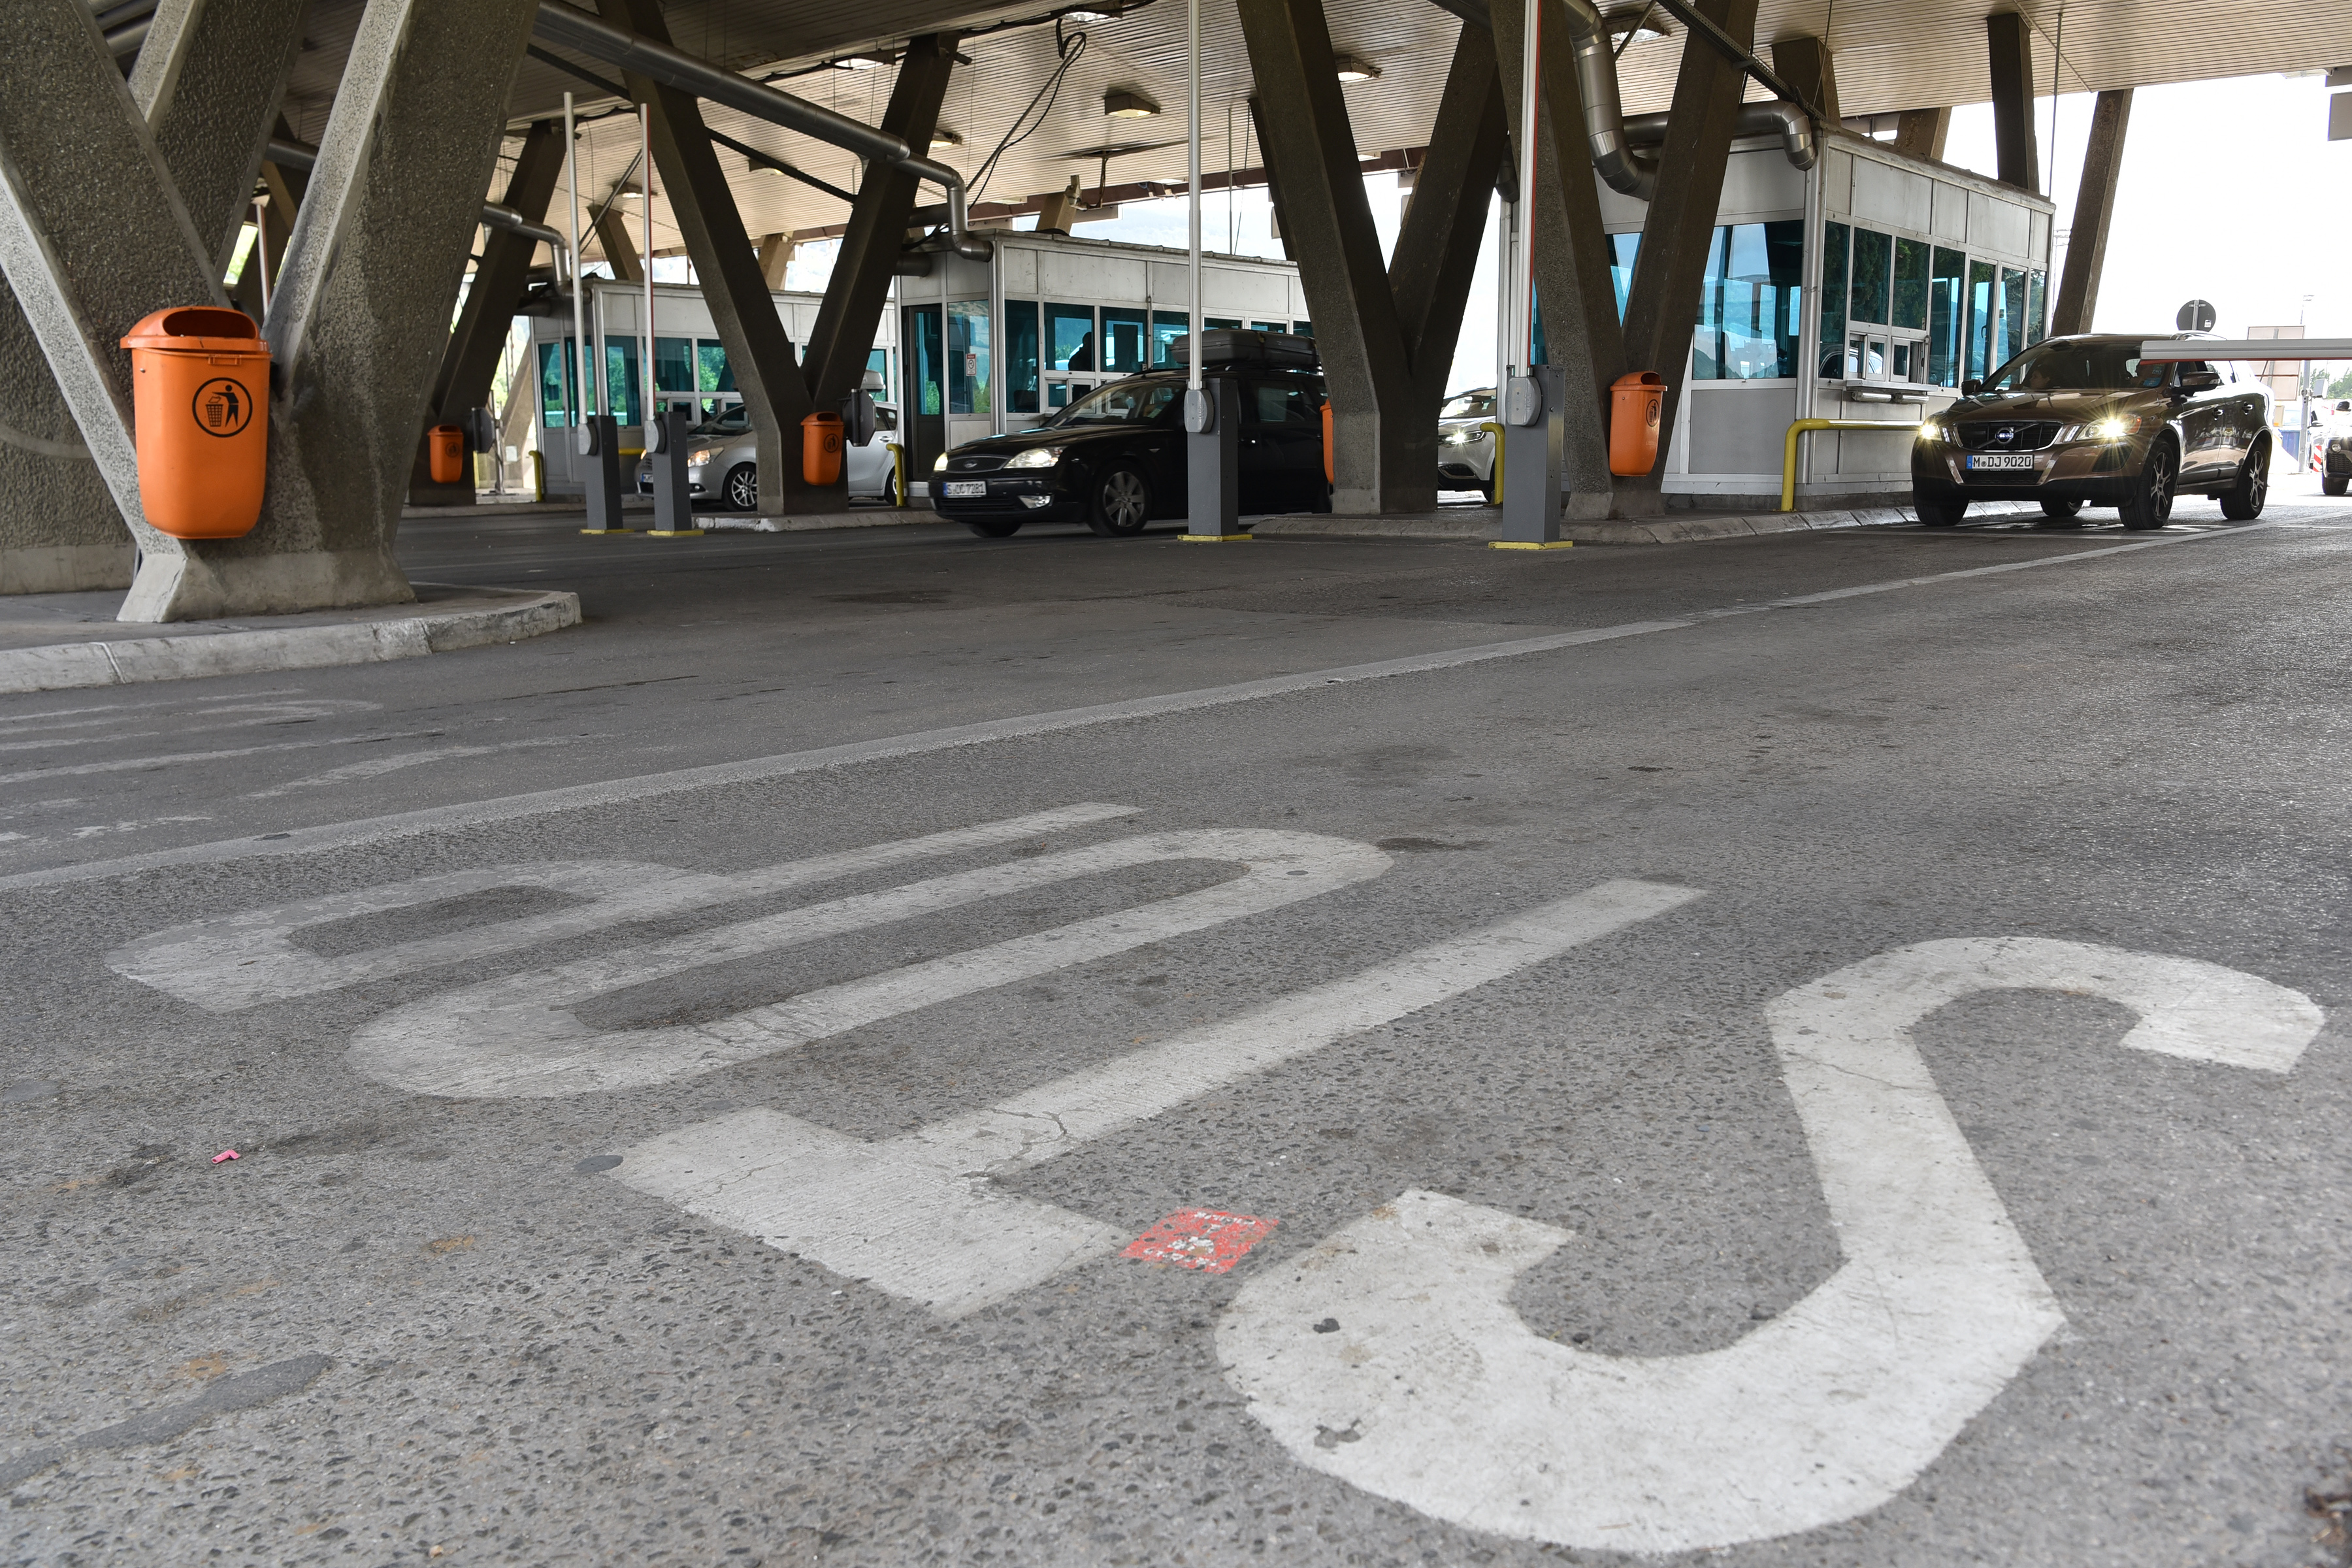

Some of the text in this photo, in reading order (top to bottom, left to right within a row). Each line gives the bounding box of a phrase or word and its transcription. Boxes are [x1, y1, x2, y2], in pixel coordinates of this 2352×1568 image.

[1973, 457, 1980, 467] M
[1987, 457, 2001, 467] DJ
[2004, 456, 2031, 467] 9020
[106, 803, 2327, 1552] STOP
